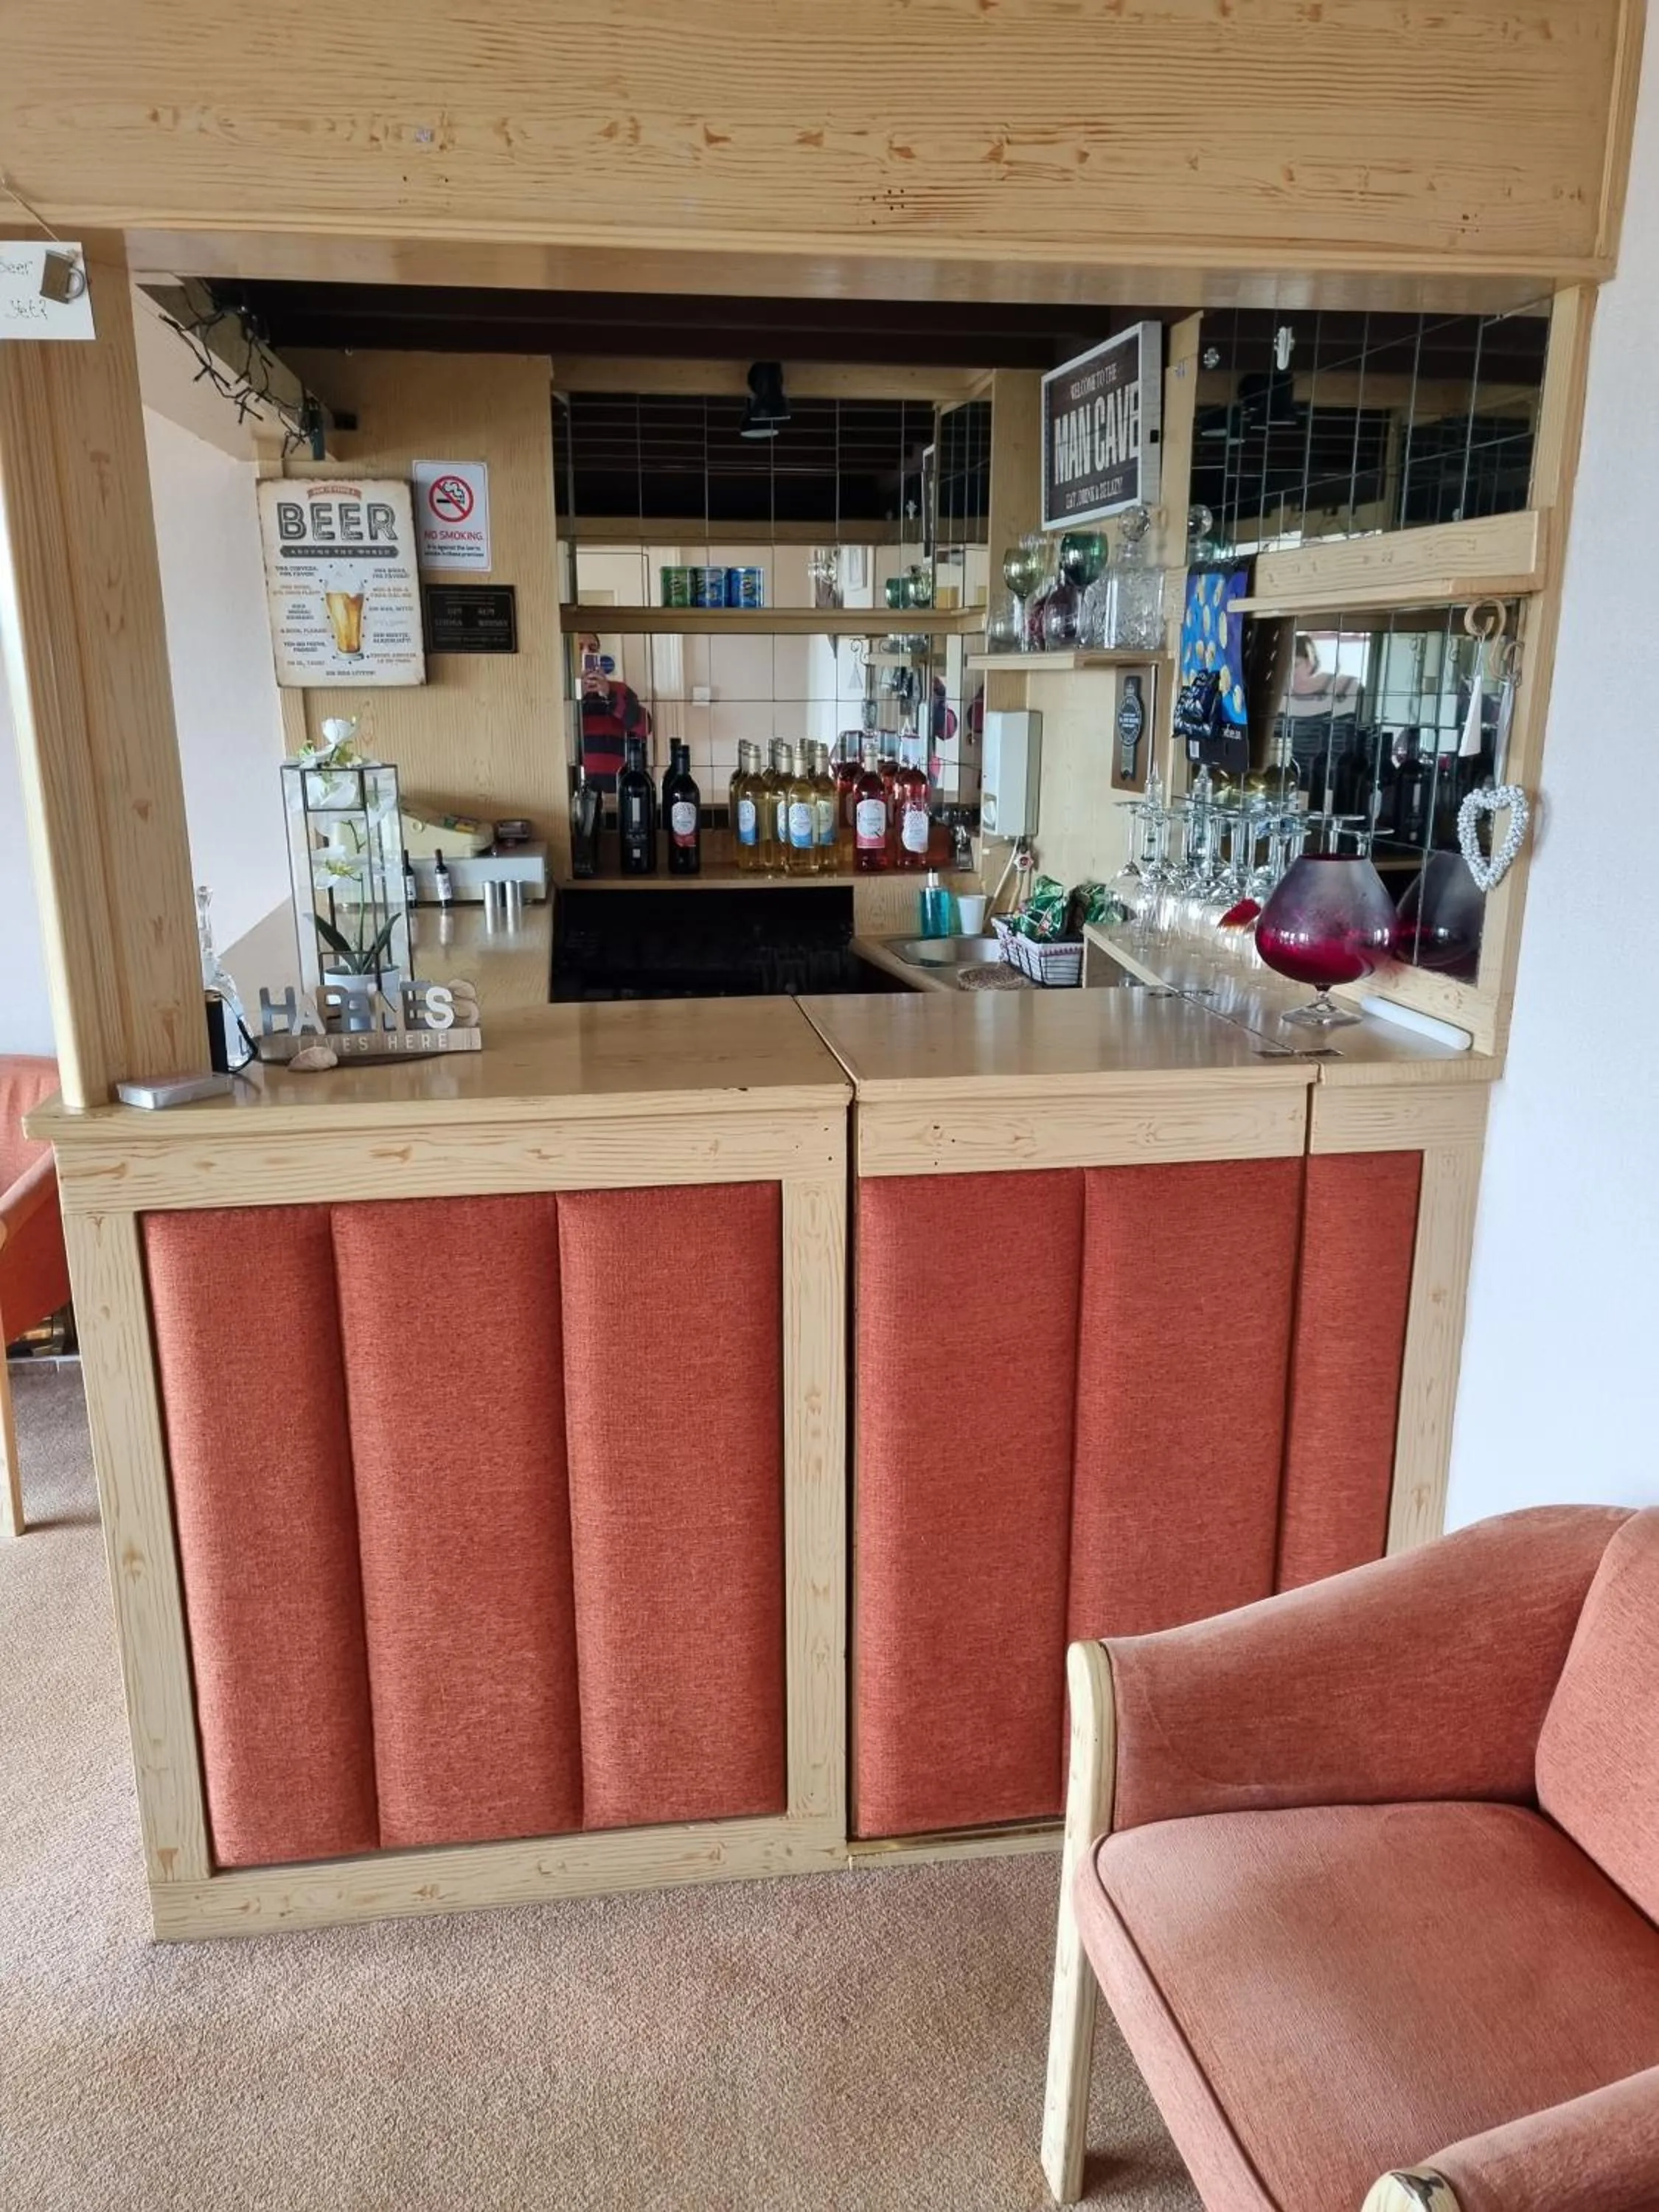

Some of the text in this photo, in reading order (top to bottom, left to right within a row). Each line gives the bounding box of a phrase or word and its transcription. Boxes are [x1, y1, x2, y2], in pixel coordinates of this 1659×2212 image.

[1071, 378, 1096, 401] WELCOME
[1106, 363, 1117, 382] THE
[1055, 380, 1139, 484] MAN CAVE
[277, 502, 398, 541] BEER
[424, 530, 484, 540] NO SMOKING
[387, 1033, 448, 1051] HERE
